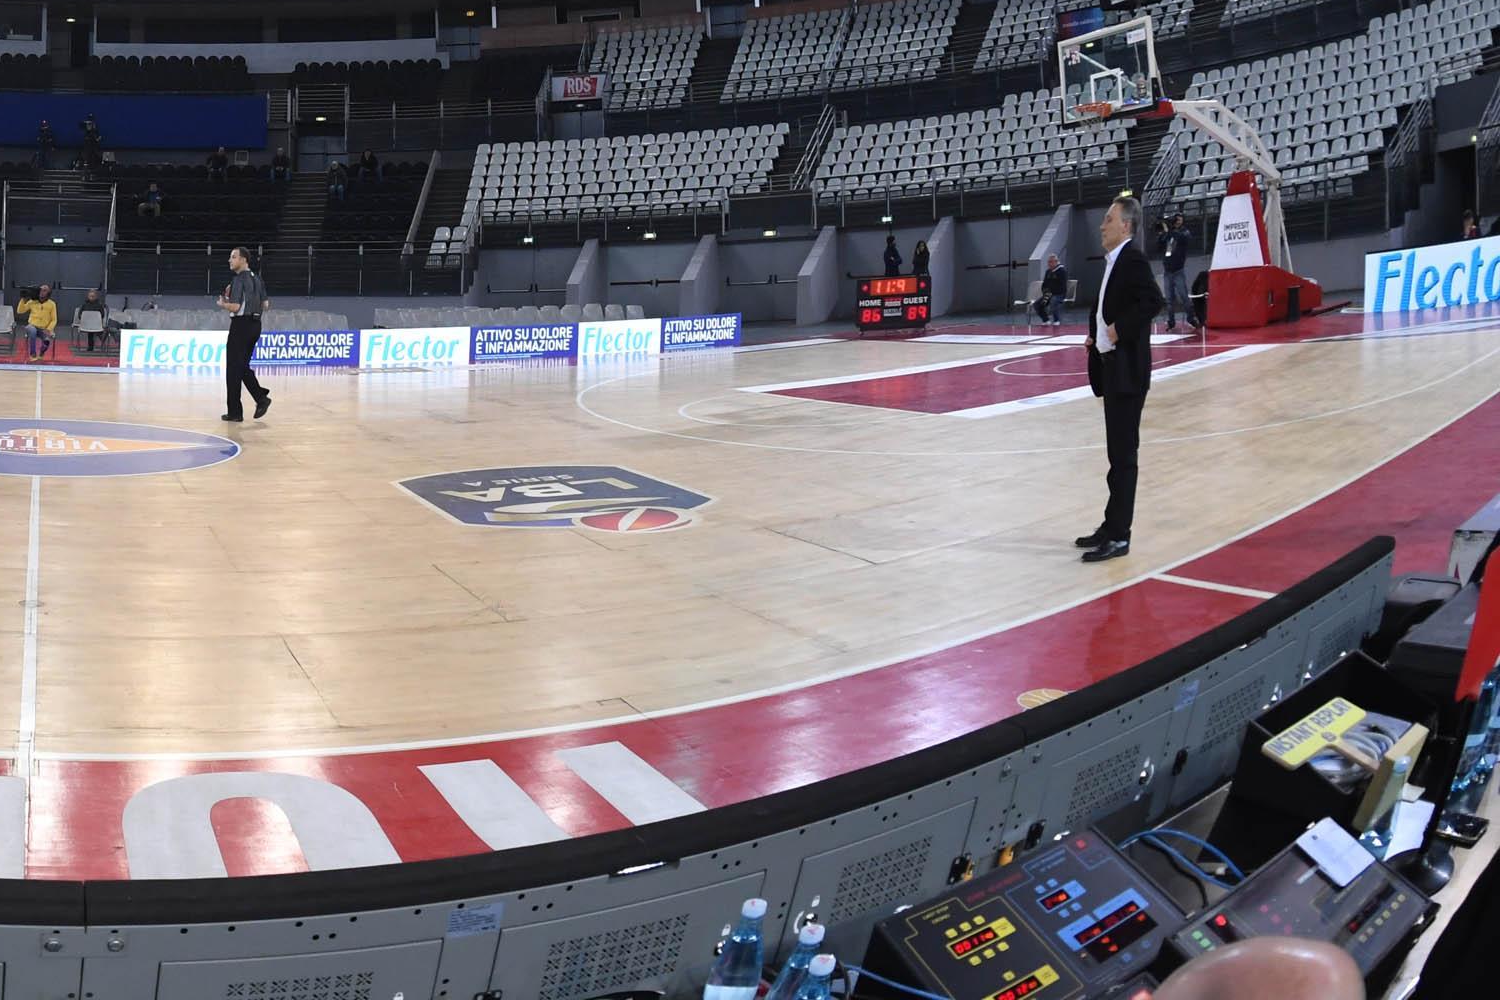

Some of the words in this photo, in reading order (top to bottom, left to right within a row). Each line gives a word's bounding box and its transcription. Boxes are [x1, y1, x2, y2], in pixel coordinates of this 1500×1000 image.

[567, 77, 592, 94] RDS
[1224, 221, 1250, 231] IMPRESIT
[1224, 230, 1250, 242] LAVORI
[1372, 245, 1500, 313] Flecto
[859, 299, 881, 307] HOME
[903, 296, 928, 305] GUEST
[665, 318, 692, 332] ATTIVO
[693, 317, 705, 331] SU
[705, 316, 737, 330] DOLORE
[255, 334, 286, 346] TIVO
[288, 334, 305, 346] SU
[307, 333, 354, 346] DOLORE
[475, 328, 513, 342] ATTIVO
[515, 327, 530, 341] SU
[532, 326, 573, 340] DOLORE
[583, 326, 652, 354] Flector
[665, 332, 670, 344] E
[671, 328, 735, 343] INFIAMMAZIONE
[126, 335, 227, 365] Flector
[256, 346, 350, 359] INFIAMMAZIONE
[366, 332, 459, 362] Flector
[476, 342, 482, 354] E
[485, 339, 570, 354] INFIAMMAZIONE
[495, 474, 575, 485] SERIE
[436, 476, 639, 502] LBA
[1266, 722, 1318, 757] INSTANT
[1309, 699, 1352, 729] REPLAY
